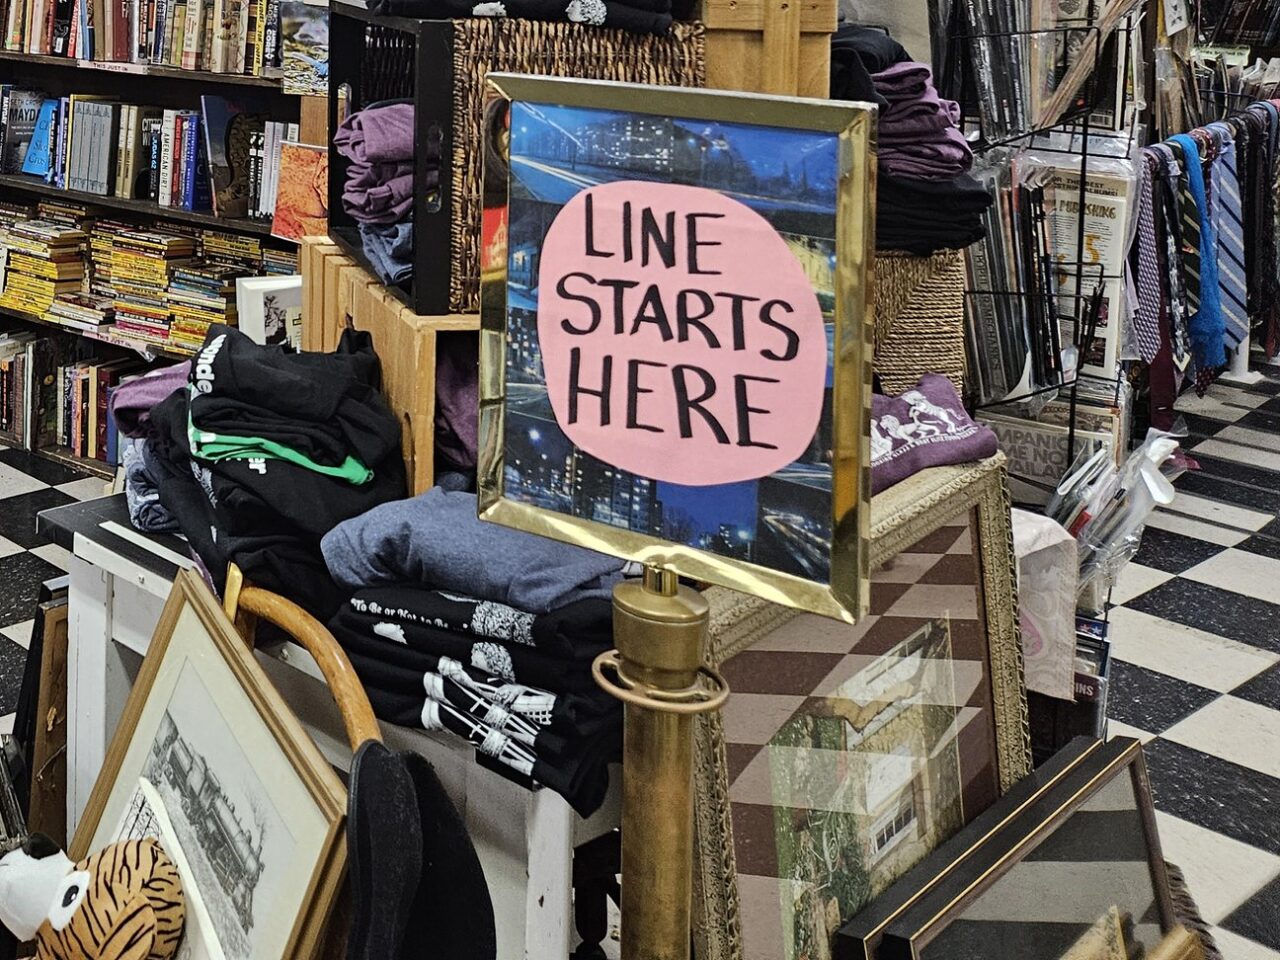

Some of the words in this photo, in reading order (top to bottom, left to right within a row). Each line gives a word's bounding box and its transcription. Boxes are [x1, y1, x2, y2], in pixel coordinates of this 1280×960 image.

[264, 28, 272, 60] COREY
[1, 96, 9, 125] MAYDAY
[161, 132, 170, 170] AMERICAN
[160, 172, 168, 189] DIRT
[583, 192, 726, 276] LINE
[555, 271, 801, 362] STARTS
[979, 306, 1001, 371] MECHANICS
[568, 346, 781, 450] HERE
